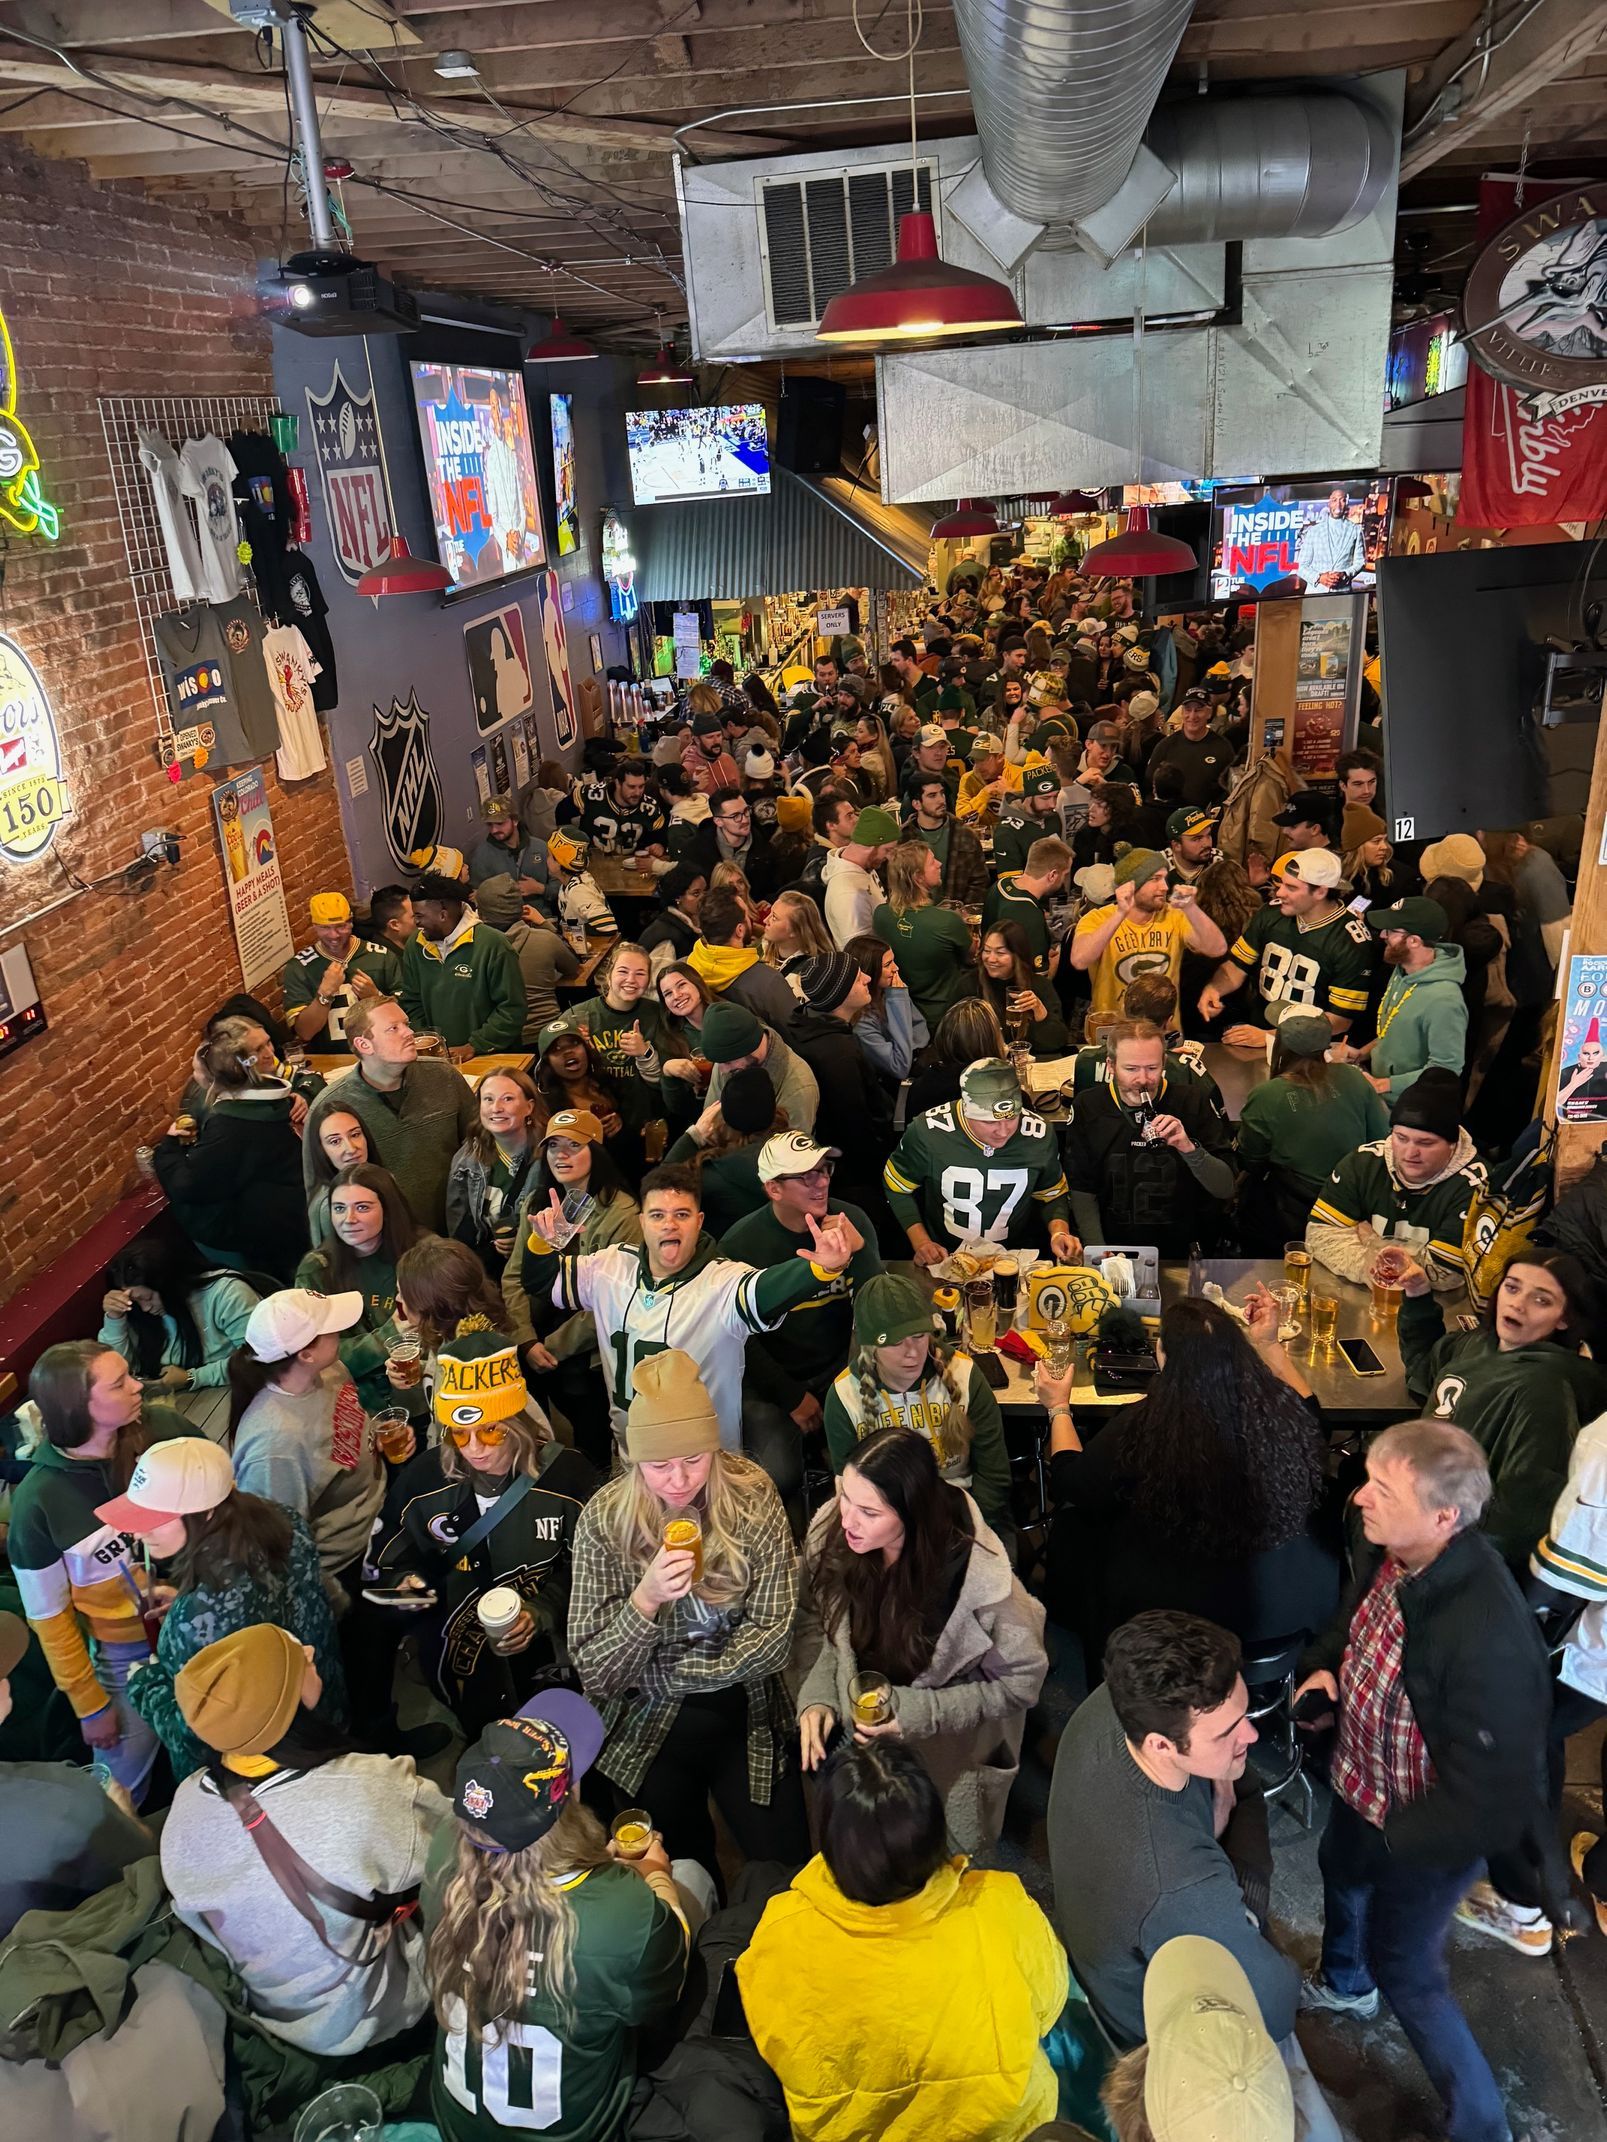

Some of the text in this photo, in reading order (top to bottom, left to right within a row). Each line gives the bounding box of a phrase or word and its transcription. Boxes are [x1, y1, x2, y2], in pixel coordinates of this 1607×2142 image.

[436, 419, 486, 457] INSIDE
[437, 455, 463, 482] THE
[328, 469, 391, 566] NFL
[443, 476, 493, 537] NFL
[1231, 510, 1304, 533] INSIDE
[1226, 532, 1261, 547] THE
[1229, 541, 1300, 577] NFL
[820, 612, 846, 620] SERVERS
[825, 621, 842, 629] ONLY
[1298, 701, 1343, 710] FEELING HOT?
[176, 739, 200, 752] SWANKY'S
[180, 729, 198, 741] OPENED
[2, 783, 27, 799] SINCE
[238, 780, 259, 797] COLORADO
[397, 743, 426, 849] NHL
[3, 786, 54, 833] 150
[21, 824, 46, 840] YEARS
[1397, 819, 1413, 840] 12
[235, 896, 253, 916] (BEER
[263, 874, 281, 895] SHOT)
[236, 865, 275, 898] HAPPY MEALS
[1259, 942, 1321, 1006] 88
[924, 1101, 956, 1132] 87
[941, 1165, 1029, 1242] 87
[535, 1514, 564, 1541] NF
[442, 1992, 563, 2131] 10
